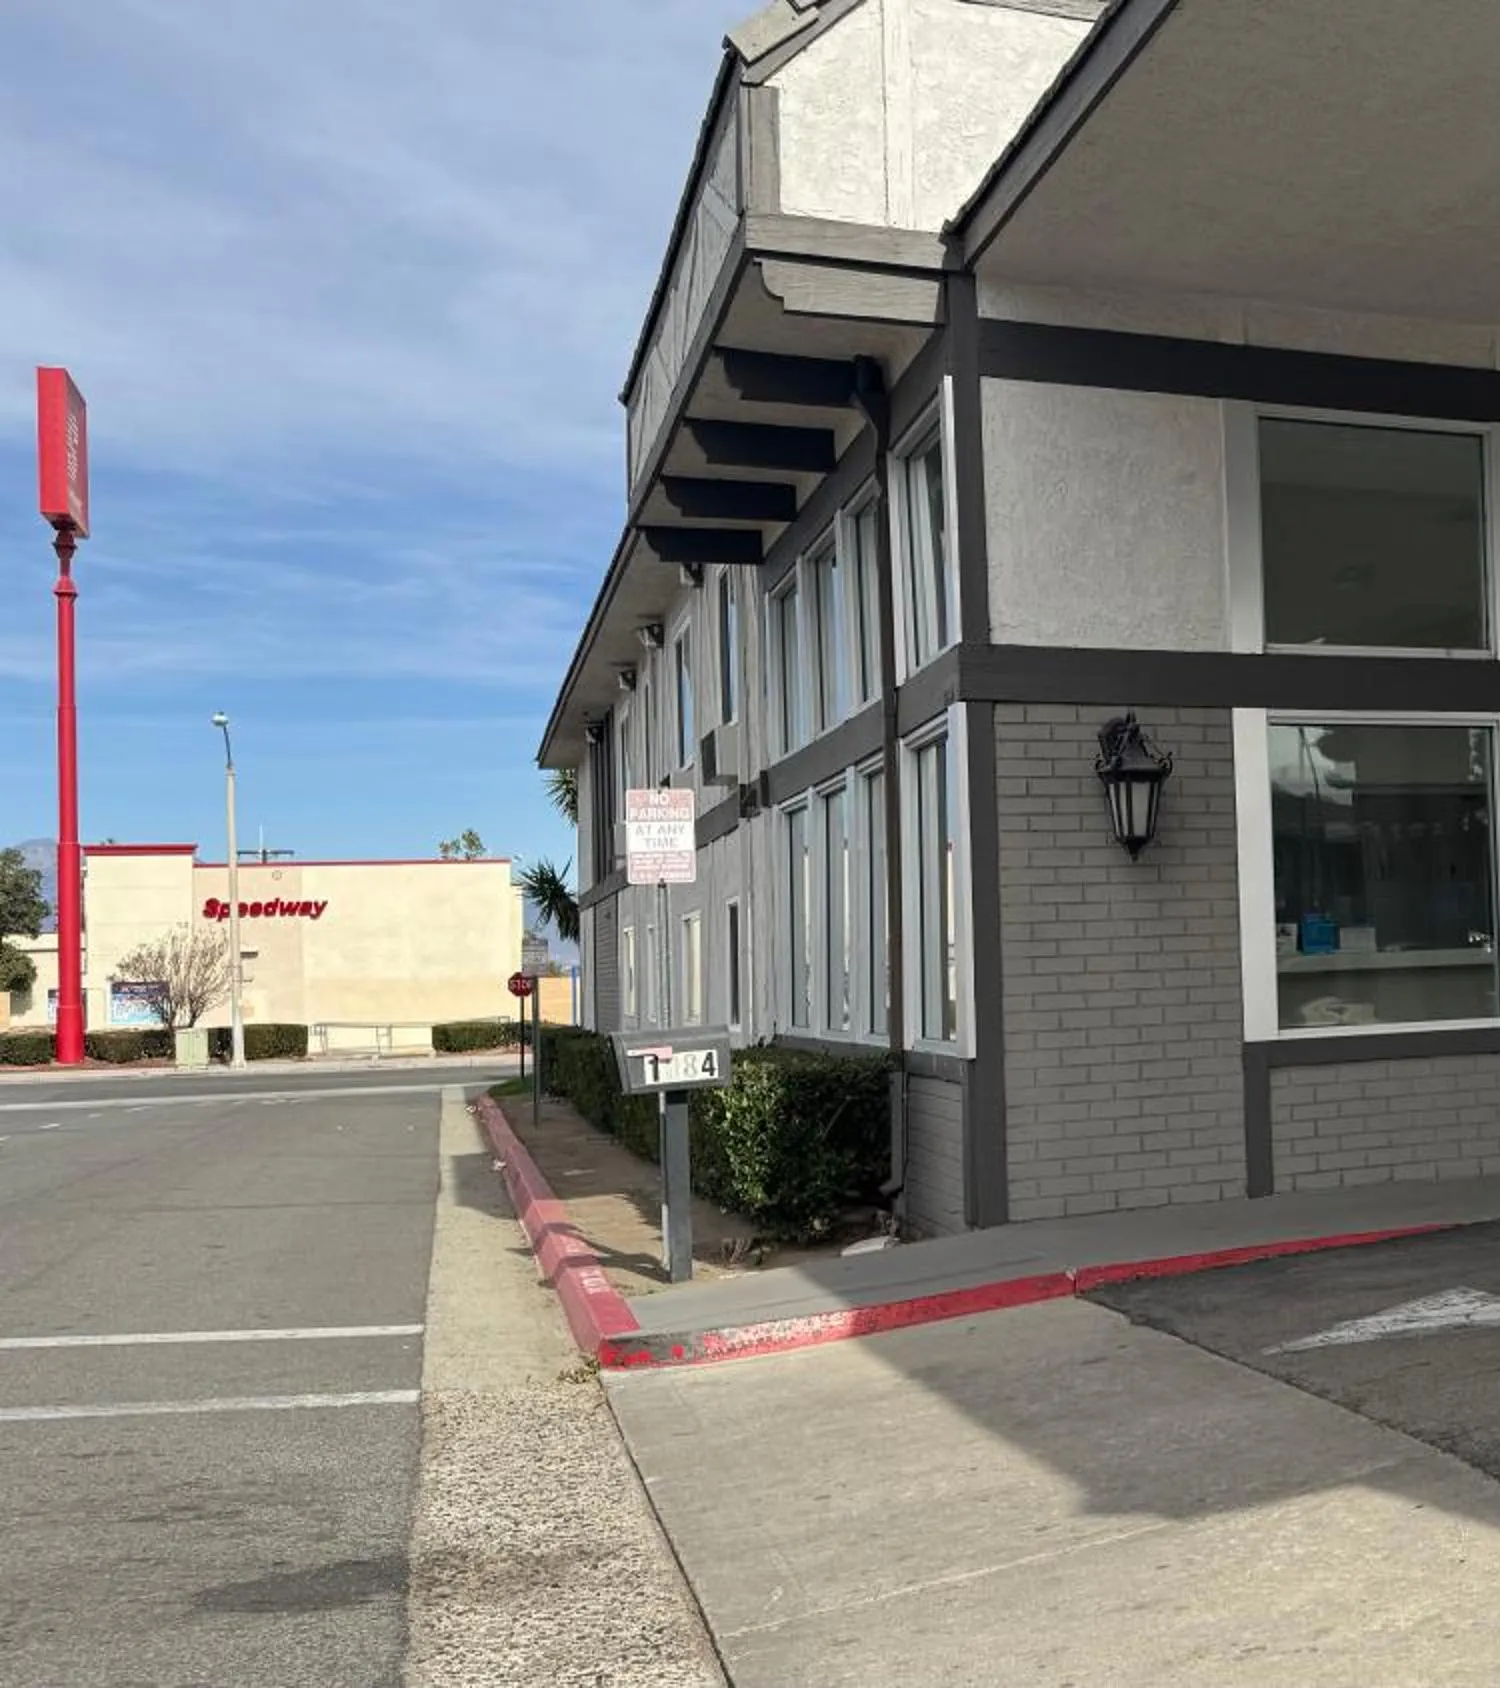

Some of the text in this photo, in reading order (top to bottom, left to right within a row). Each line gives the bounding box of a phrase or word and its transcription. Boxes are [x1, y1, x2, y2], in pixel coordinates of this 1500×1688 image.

[649, 790, 670, 805] NO
[630, 807, 690, 820] PARKING
[635, 823, 685, 836] AT ANY
[643, 837, 679, 848] TIME
[203, 898, 328, 922] Speedway
